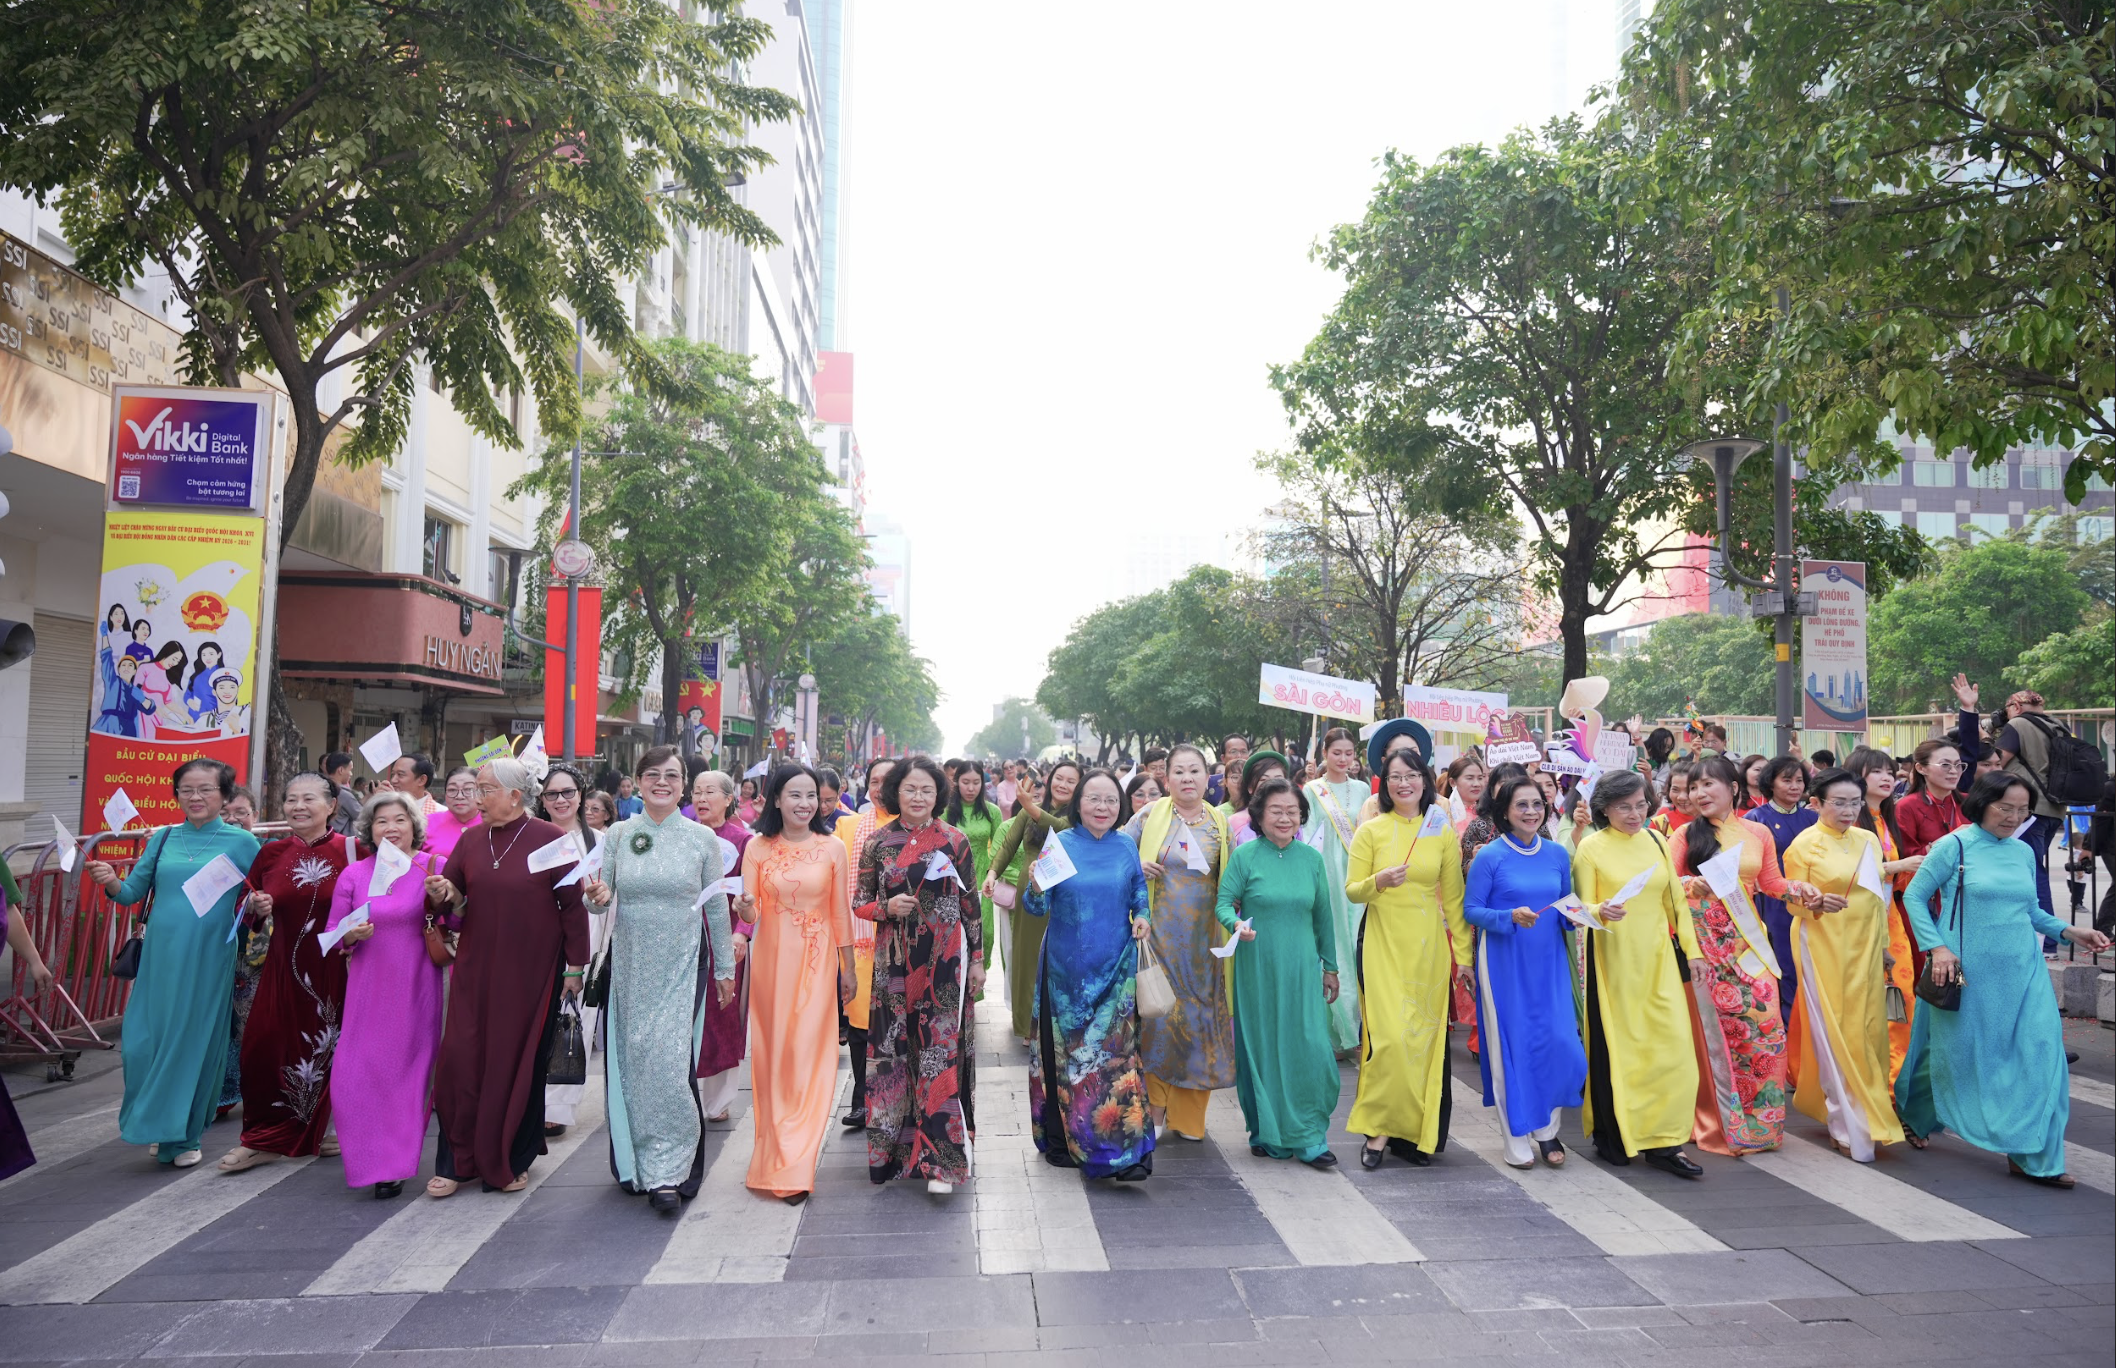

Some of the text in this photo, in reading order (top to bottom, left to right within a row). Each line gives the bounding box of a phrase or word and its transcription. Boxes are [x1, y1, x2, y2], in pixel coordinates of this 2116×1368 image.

[4, 240, 28, 270] SSI
[30, 274, 49, 303] SSI
[72, 299, 91, 324] SSI
[94, 290, 112, 316] SSI
[26, 314, 47, 341] SSI
[49, 306, 69, 333] SSI
[131, 312, 147, 335] SSI
[0, 322, 22, 350] SSI
[92, 328, 110, 353] SSI
[112, 320, 130, 344] SSI
[47, 346, 67, 370] SSI
[129, 348, 145, 370] SSI
[149, 340, 165, 362] SSI
[90, 366, 109, 389] SSI
[111, 356, 128, 379] SSI
[125, 407, 208, 452] Vikki
[212, 433, 240, 442] Digital
[122, 452, 248, 464] Ngân hàng Tiết kiệm Tốt nhất!
[211, 441, 248, 454] Bank
[187, 478, 208, 488] Chạm
[227, 480, 246, 488] hứng
[198, 488, 211, 496] bật
[212, 489, 234, 497] tương
[1818, 589, 1850, 601] KHÔNG
[1821, 608, 1837, 616] PHẠM
[1815, 638, 1827, 646] TRÁI
[1833, 627, 1845, 636] PHỐ
[426, 635, 500, 677] HUY NGÂN
[1274, 682, 1361, 715] SÀI GÒN
[1407, 700, 1462, 722] NHIÊU
[116, 747, 135, 760] BẦU
[139, 750, 155, 760] CỬ
[157, 753, 177, 764] ĐẠI
[104, 772, 133, 783] QUỐC
[136, 774, 156, 786] HỘI
[134, 796, 156, 808] BIỂU
[101, 822, 128, 831] NN
[99, 844, 126, 857] NHIỆM
